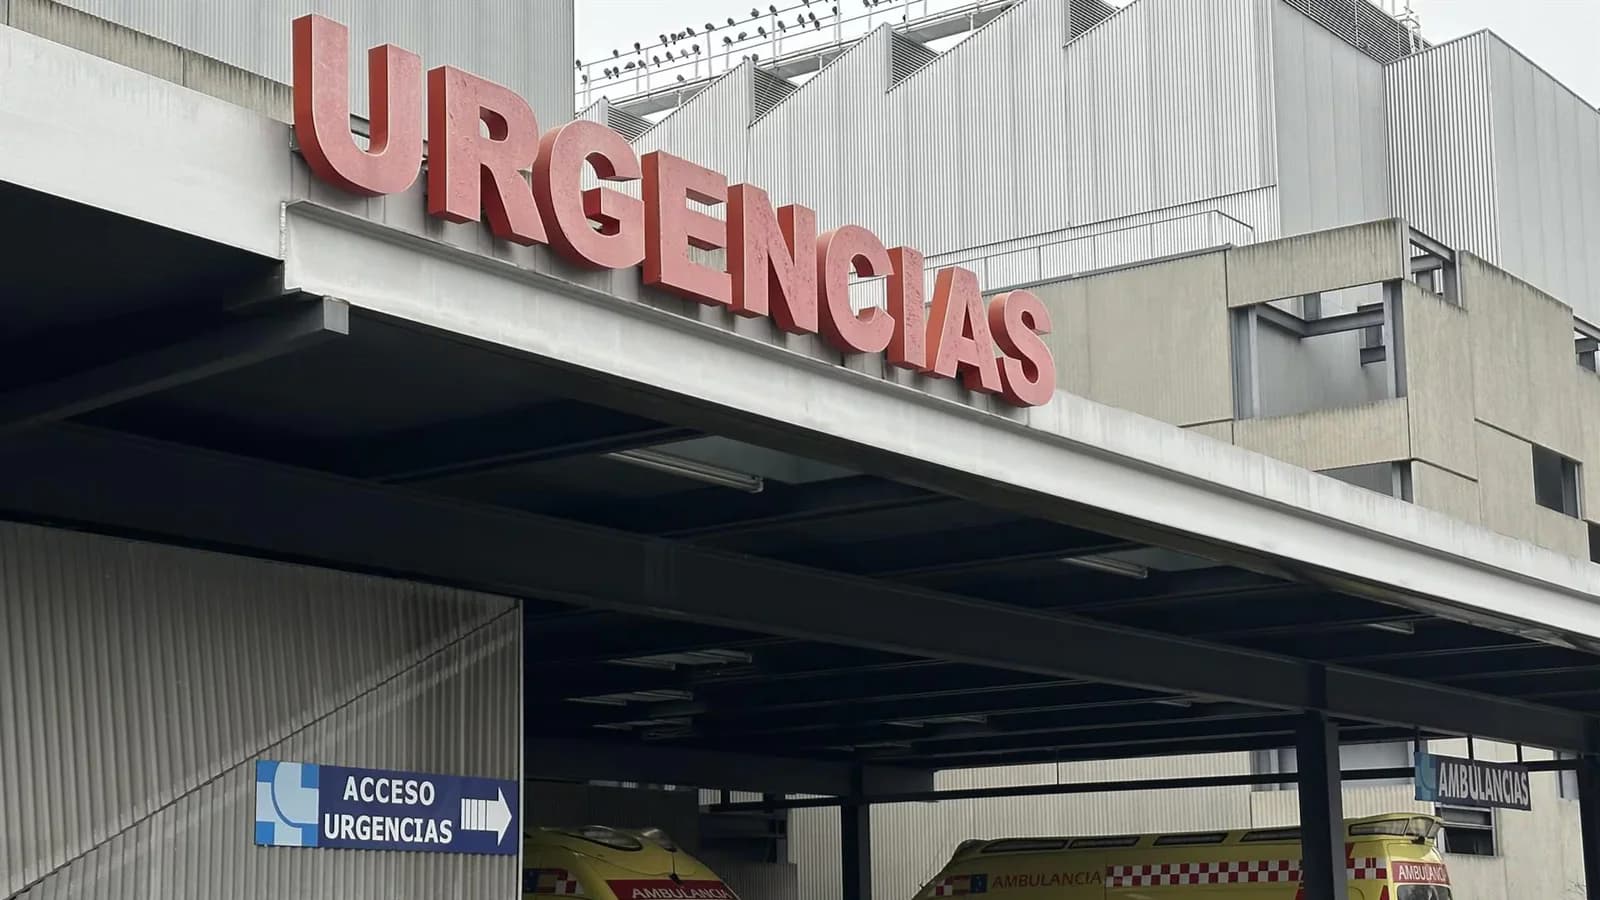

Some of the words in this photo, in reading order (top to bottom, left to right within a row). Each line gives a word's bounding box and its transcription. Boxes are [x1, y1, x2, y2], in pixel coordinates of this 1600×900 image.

[293, 13, 1056, 408] URGENCIAS
[343, 776, 435, 806] ACCESO
[1438, 762, 1529, 805] AMBULANCIAS
[324, 813, 453, 844] URGENCIAS
[631, 887, 734, 899] AMBULANCIA
[993, 871, 1102, 889] AMBULANCIA
